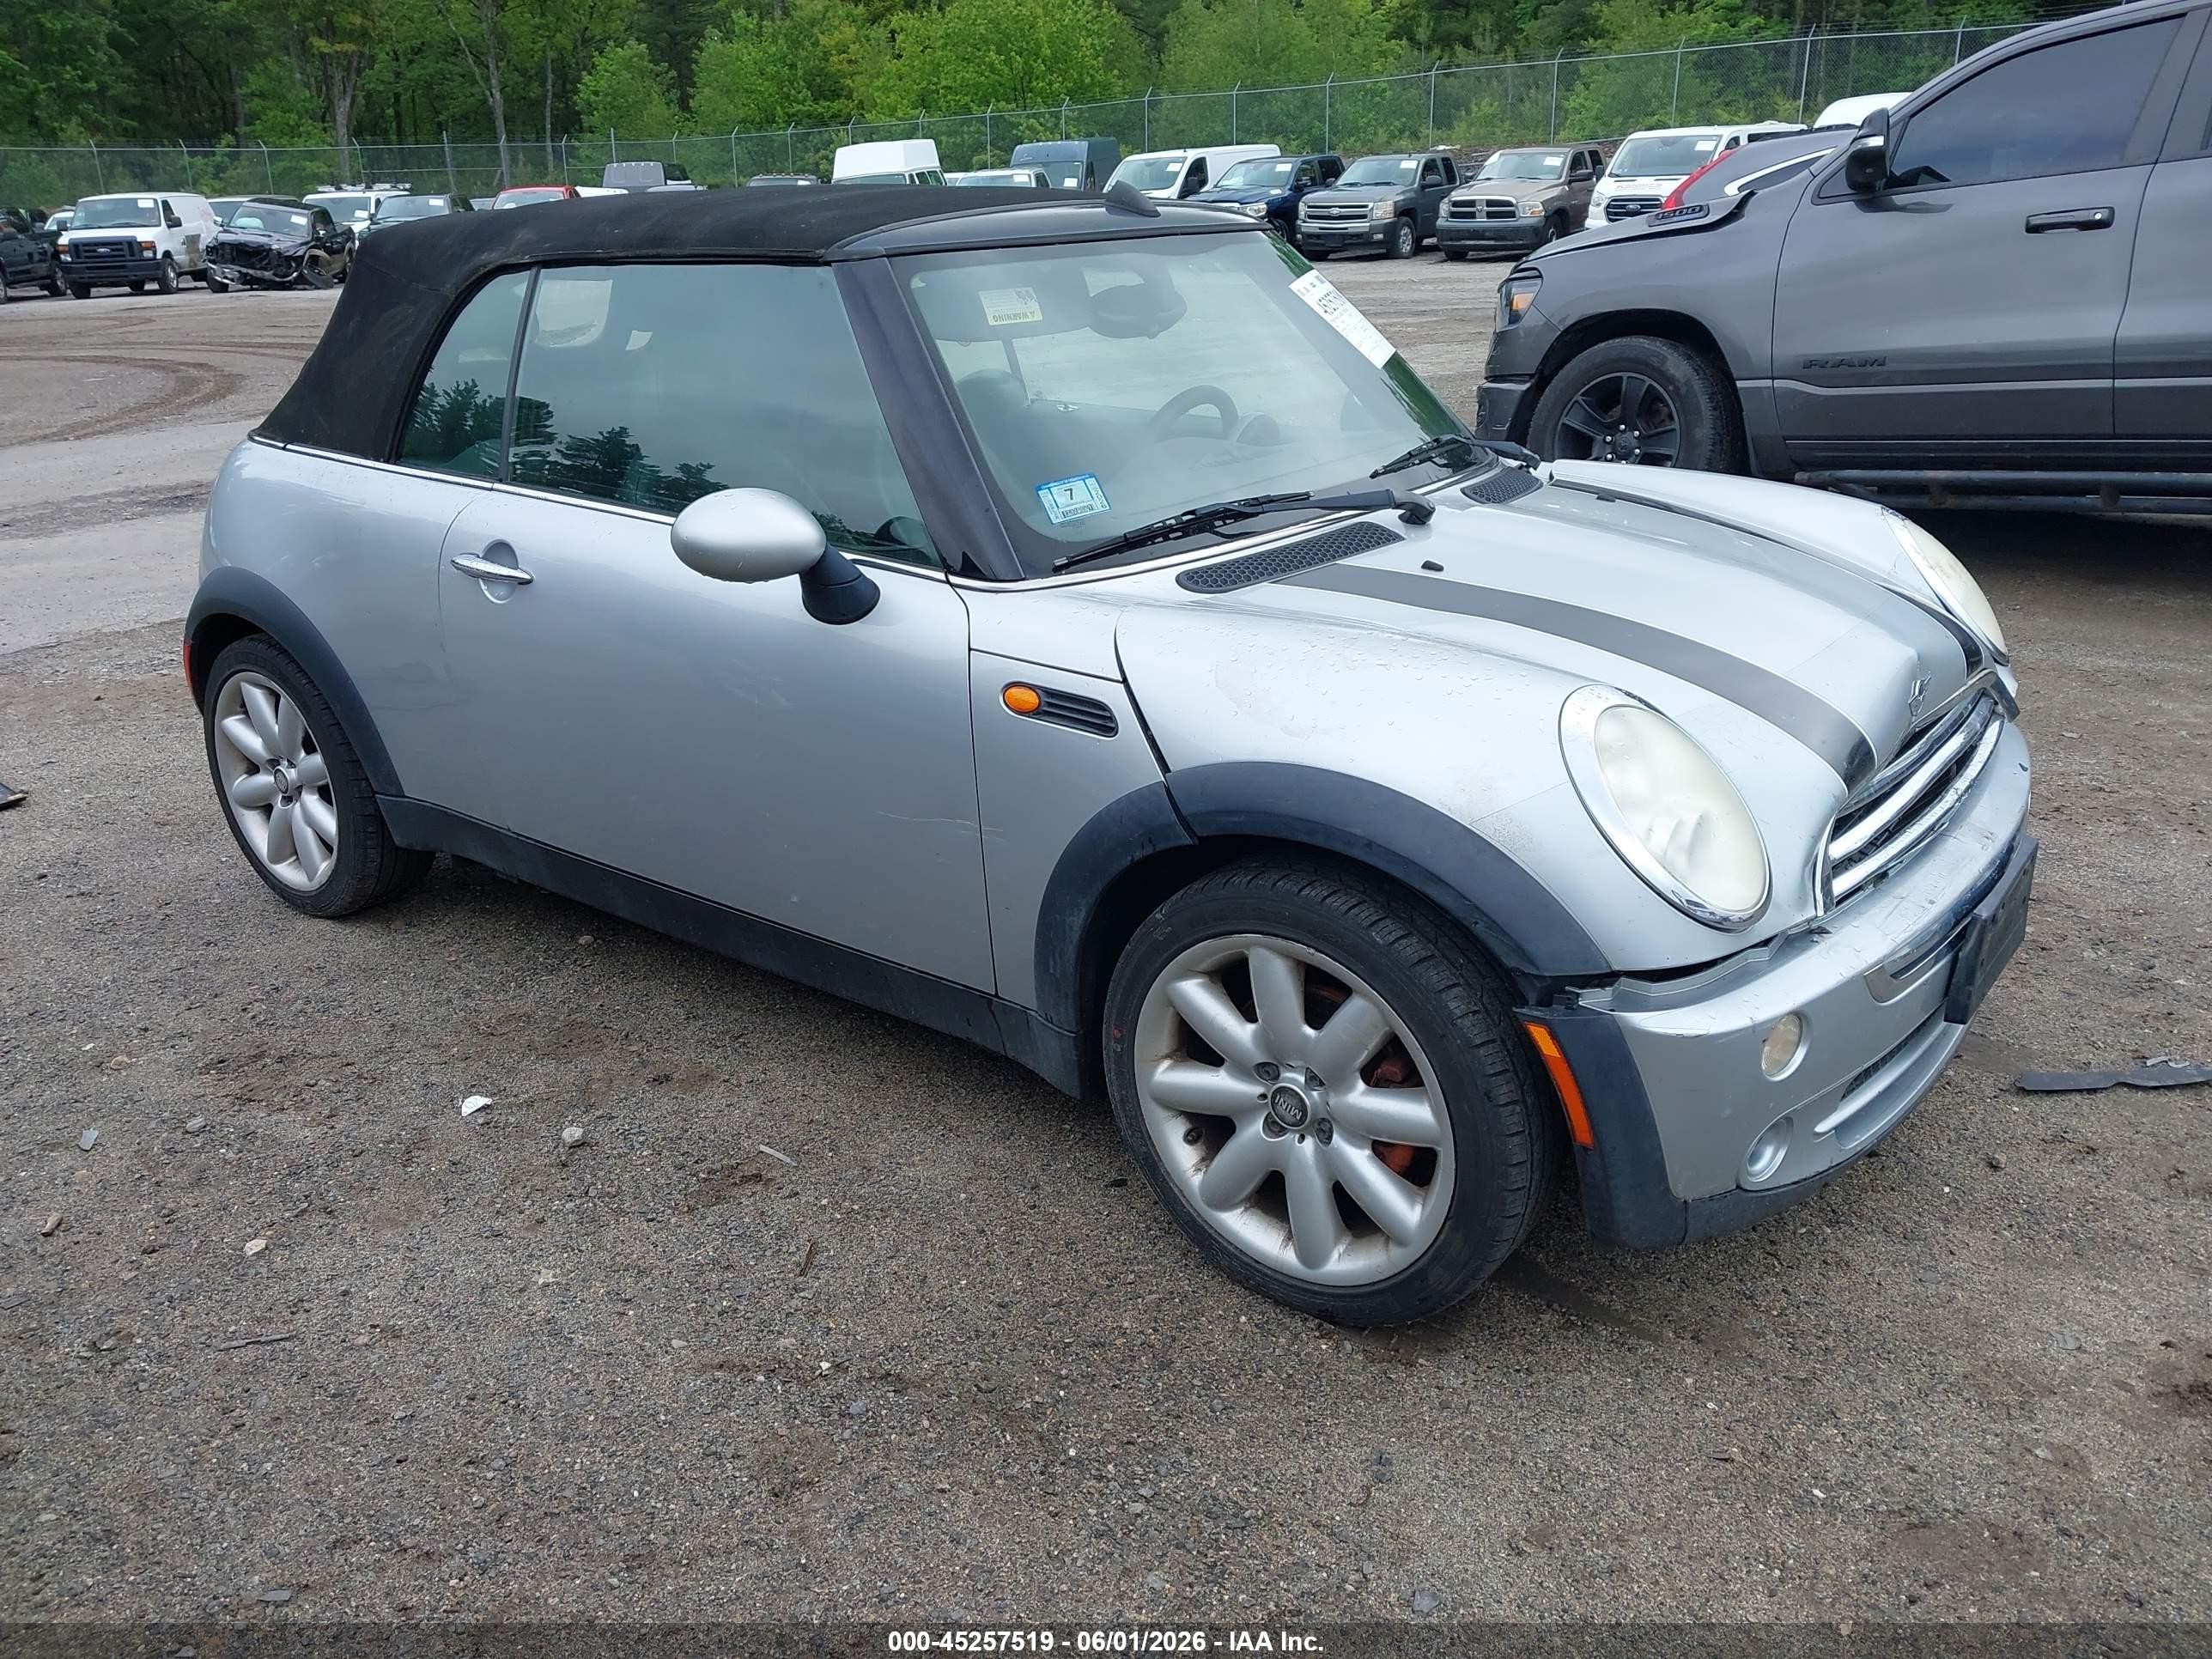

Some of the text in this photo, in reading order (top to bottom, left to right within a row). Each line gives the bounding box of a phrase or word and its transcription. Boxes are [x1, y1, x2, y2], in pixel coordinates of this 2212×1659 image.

[1657, 206, 1700, 220] 1500
[992, 310, 1030, 323] WARNING
[1802, 356, 1887, 369] RAM
[1063, 487, 1074, 501] 7
[1274, 1094, 1303, 1121] MINI
